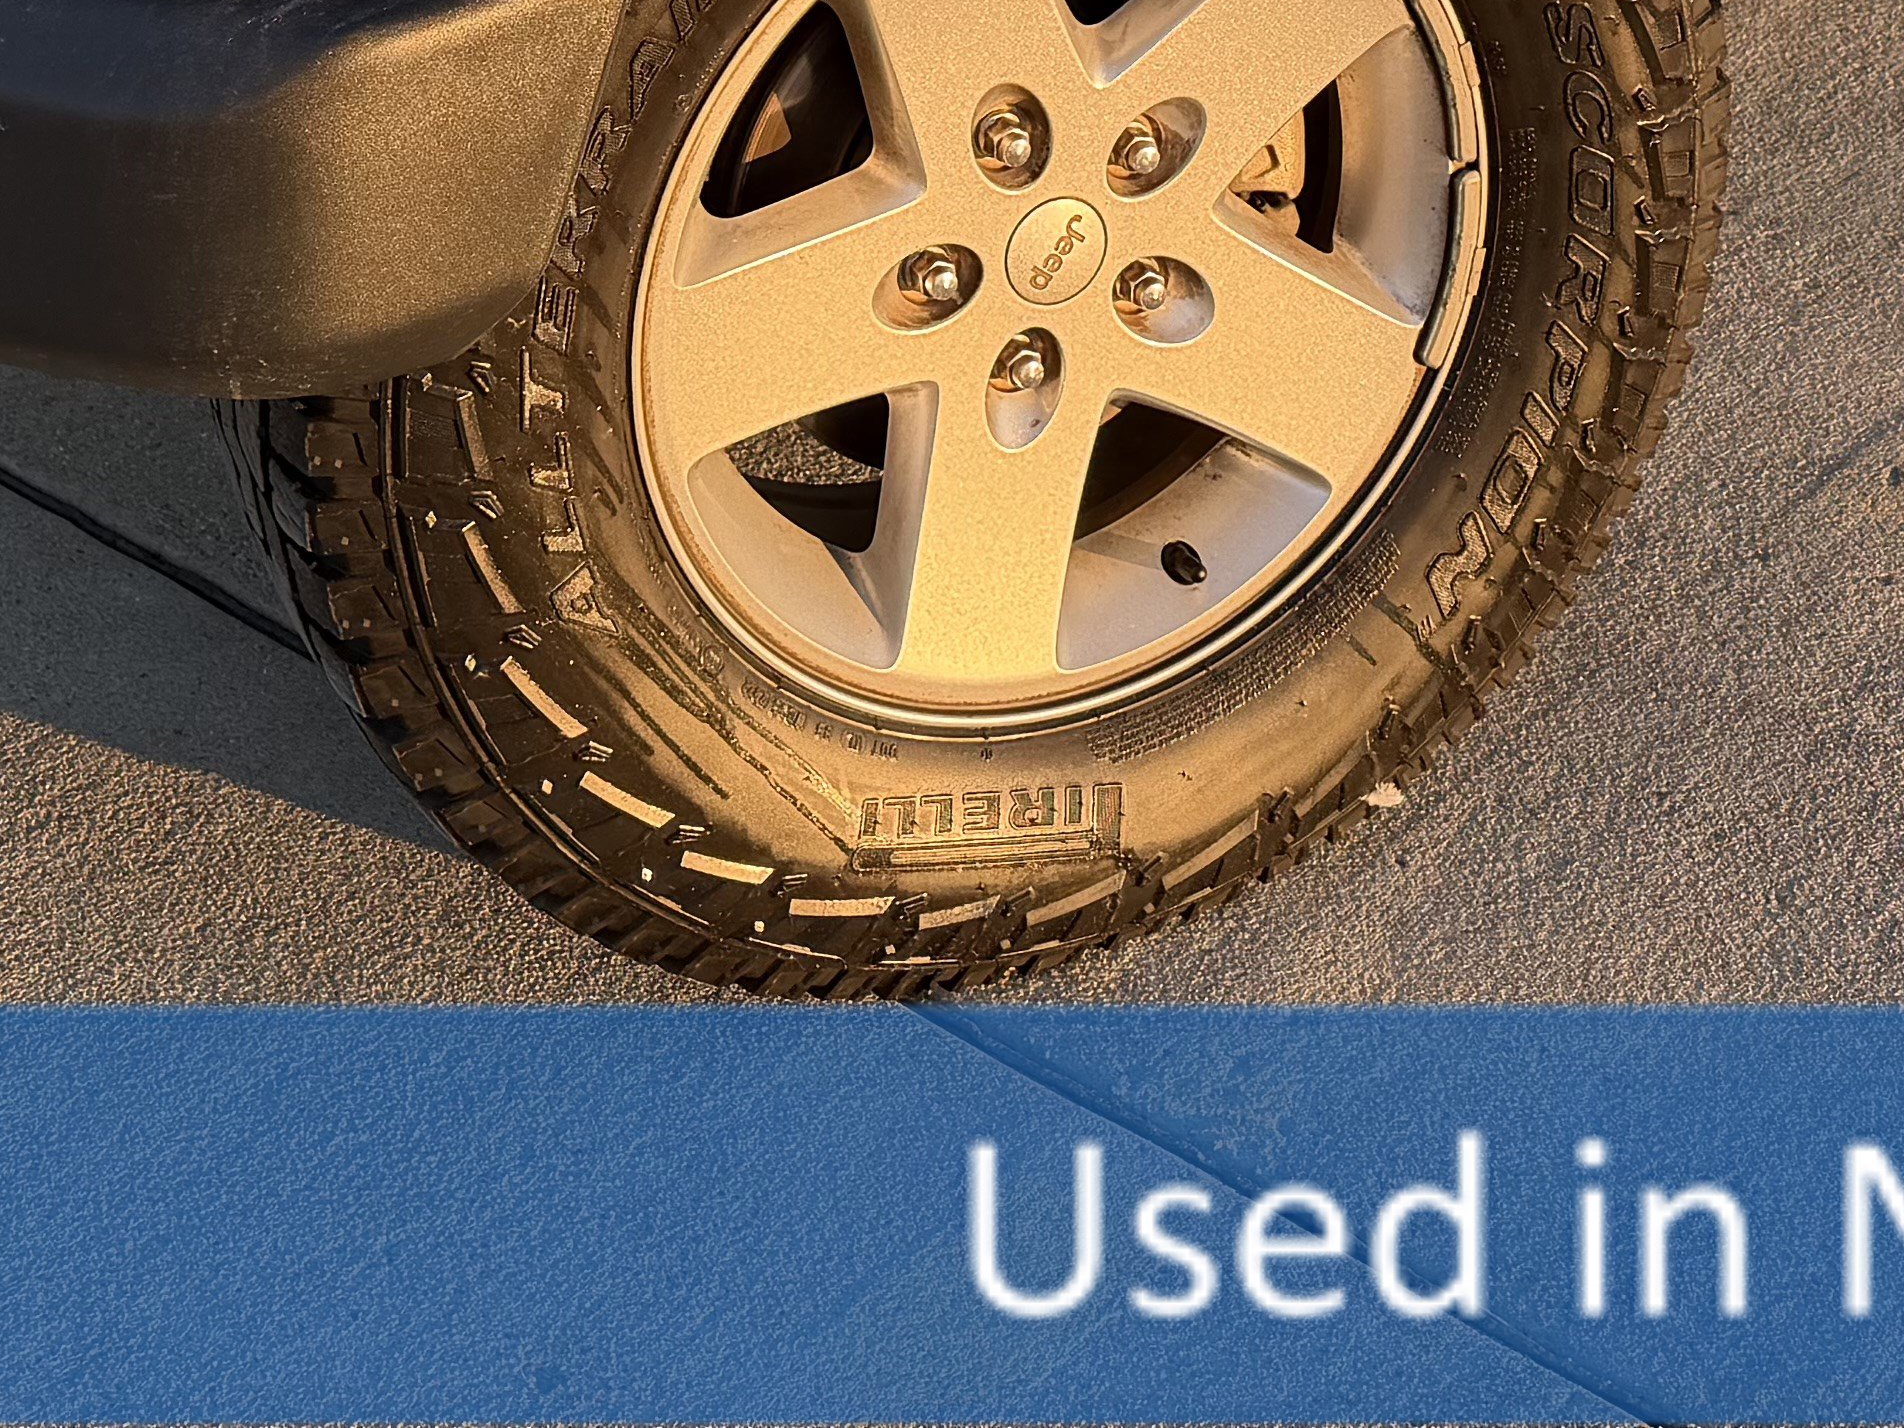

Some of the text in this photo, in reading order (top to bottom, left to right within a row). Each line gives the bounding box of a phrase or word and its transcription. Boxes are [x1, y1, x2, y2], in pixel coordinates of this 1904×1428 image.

[1029, 213, 1086, 291] Jeep
[1425, 0, 1616, 621] SCORPION
[528, 430, 620, 633] ALL
[858, 782, 1124, 873] PIRELLI
